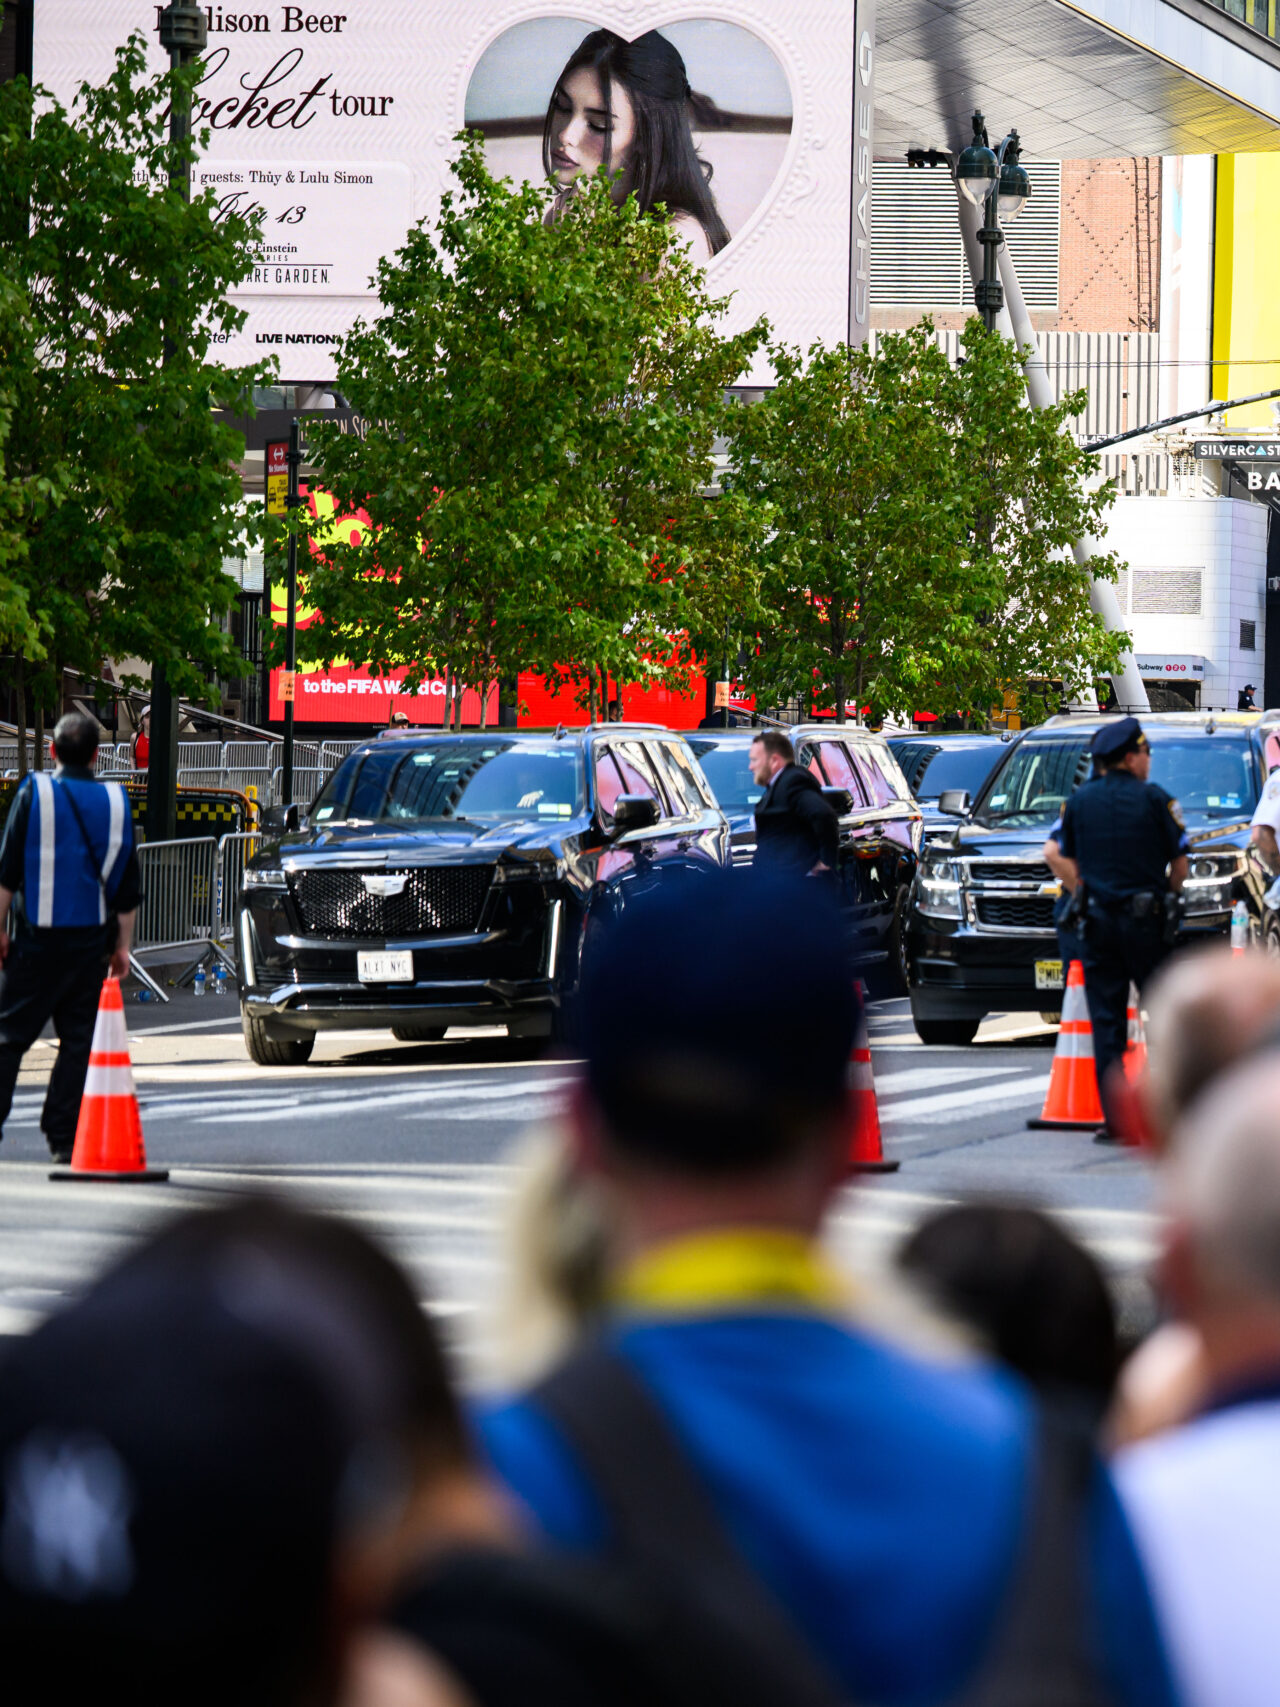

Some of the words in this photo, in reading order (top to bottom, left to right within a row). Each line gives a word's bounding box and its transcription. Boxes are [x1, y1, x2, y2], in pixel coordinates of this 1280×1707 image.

[153, 5, 270, 32] ison
[281, 6, 347, 33] Beer
[329, 88, 394, 117] tour
[200, 171, 244, 185] guests:
[286, 171, 295, 184] &
[299, 171, 329, 184] Lulu
[334, 171, 373, 184] Simon
[275, 205, 307, 224] 13
[855, 100, 871, 324] CHASE
[255, 242, 298, 253] Einstein
[253, 254, 288, 262] SRIES
[256, 334, 282, 343] LIVE
[285, 334, 337, 344] NATION
[304, 679, 319, 693] to
[321, 679, 346, 693] the
[347, 680, 380, 694] FIFA
